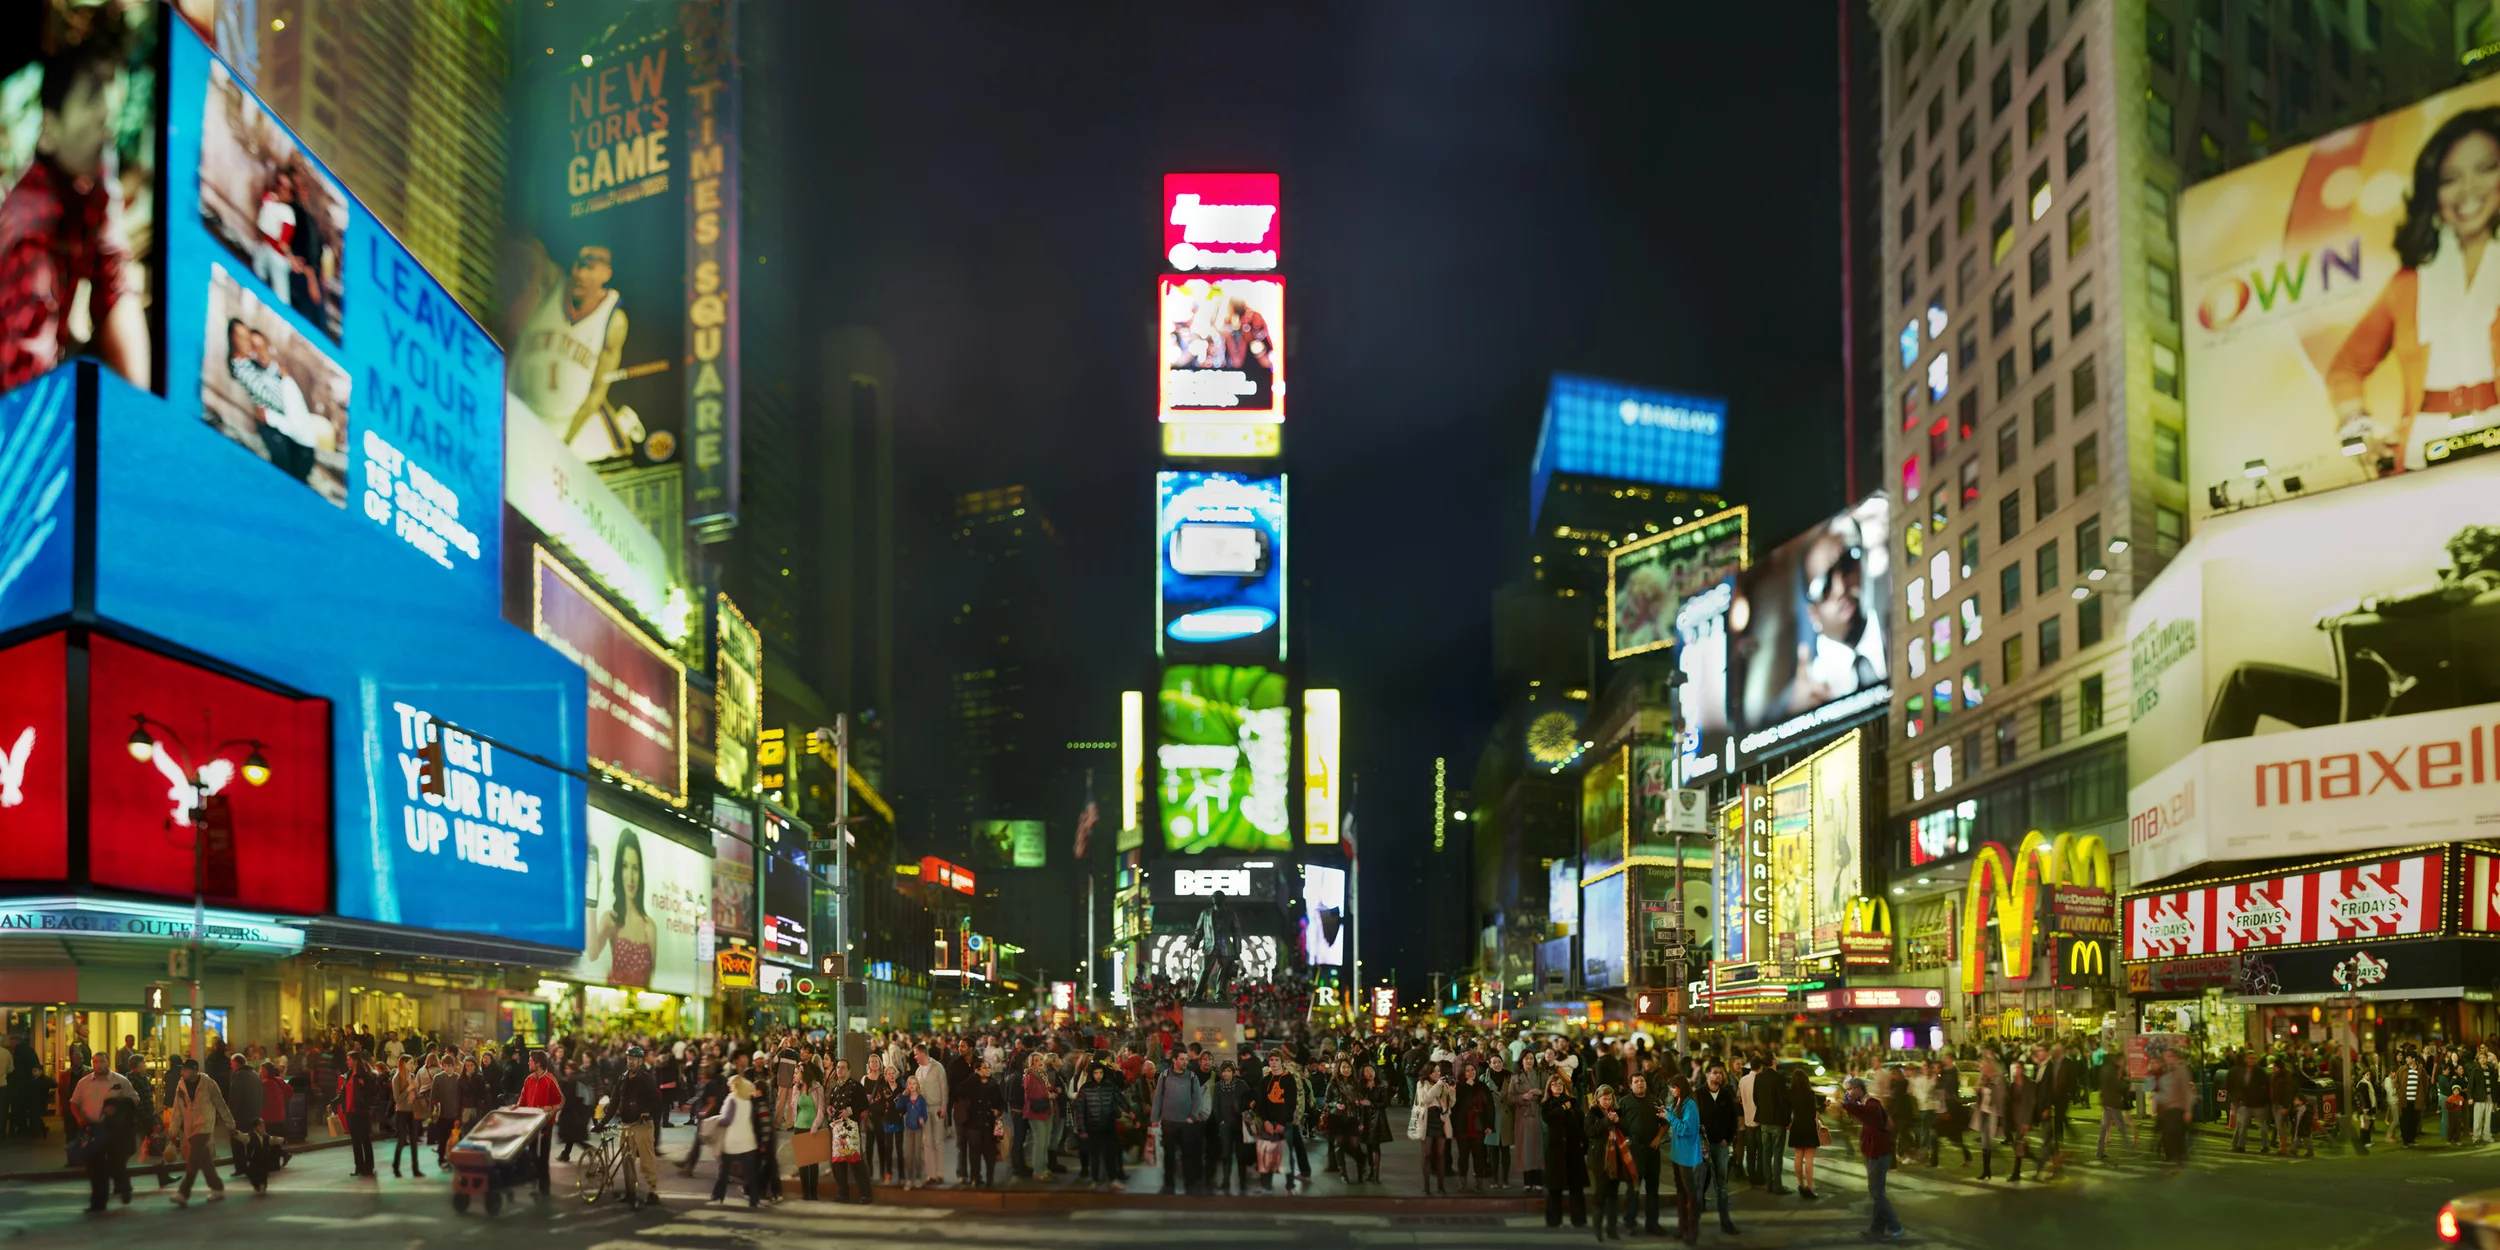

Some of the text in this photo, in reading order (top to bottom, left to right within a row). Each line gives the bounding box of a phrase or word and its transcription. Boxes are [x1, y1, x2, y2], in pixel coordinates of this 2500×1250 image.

[569, 48, 668, 125] NEW
[570, 98, 670, 154] YORK'S
[568, 128, 670, 197] GAME
[687, 79, 724, 246] TIMES
[370, 235, 478, 378] LEAVE
[2198, 238, 2362, 332] OWN
[383, 308, 479, 440] YOUR
[690, 260, 728, 467] SQUARE
[366, 364, 478, 500] MARK
[444, 721, 493, 777] GET
[403, 805, 449, 855] UP
[485, 781, 544, 835] FACE
[2131, 780, 2196, 848] maxell
[1174, 869, 1251, 896] BEEN
[1753, 796, 1767, 925] PALACE
[42, 914, 120, 932] EAGLE
[2055, 892, 2114, 908] McDonald's
[1661, 932, 1675, 940] ONE
[2340, 967, 2379, 978] FDAYS
